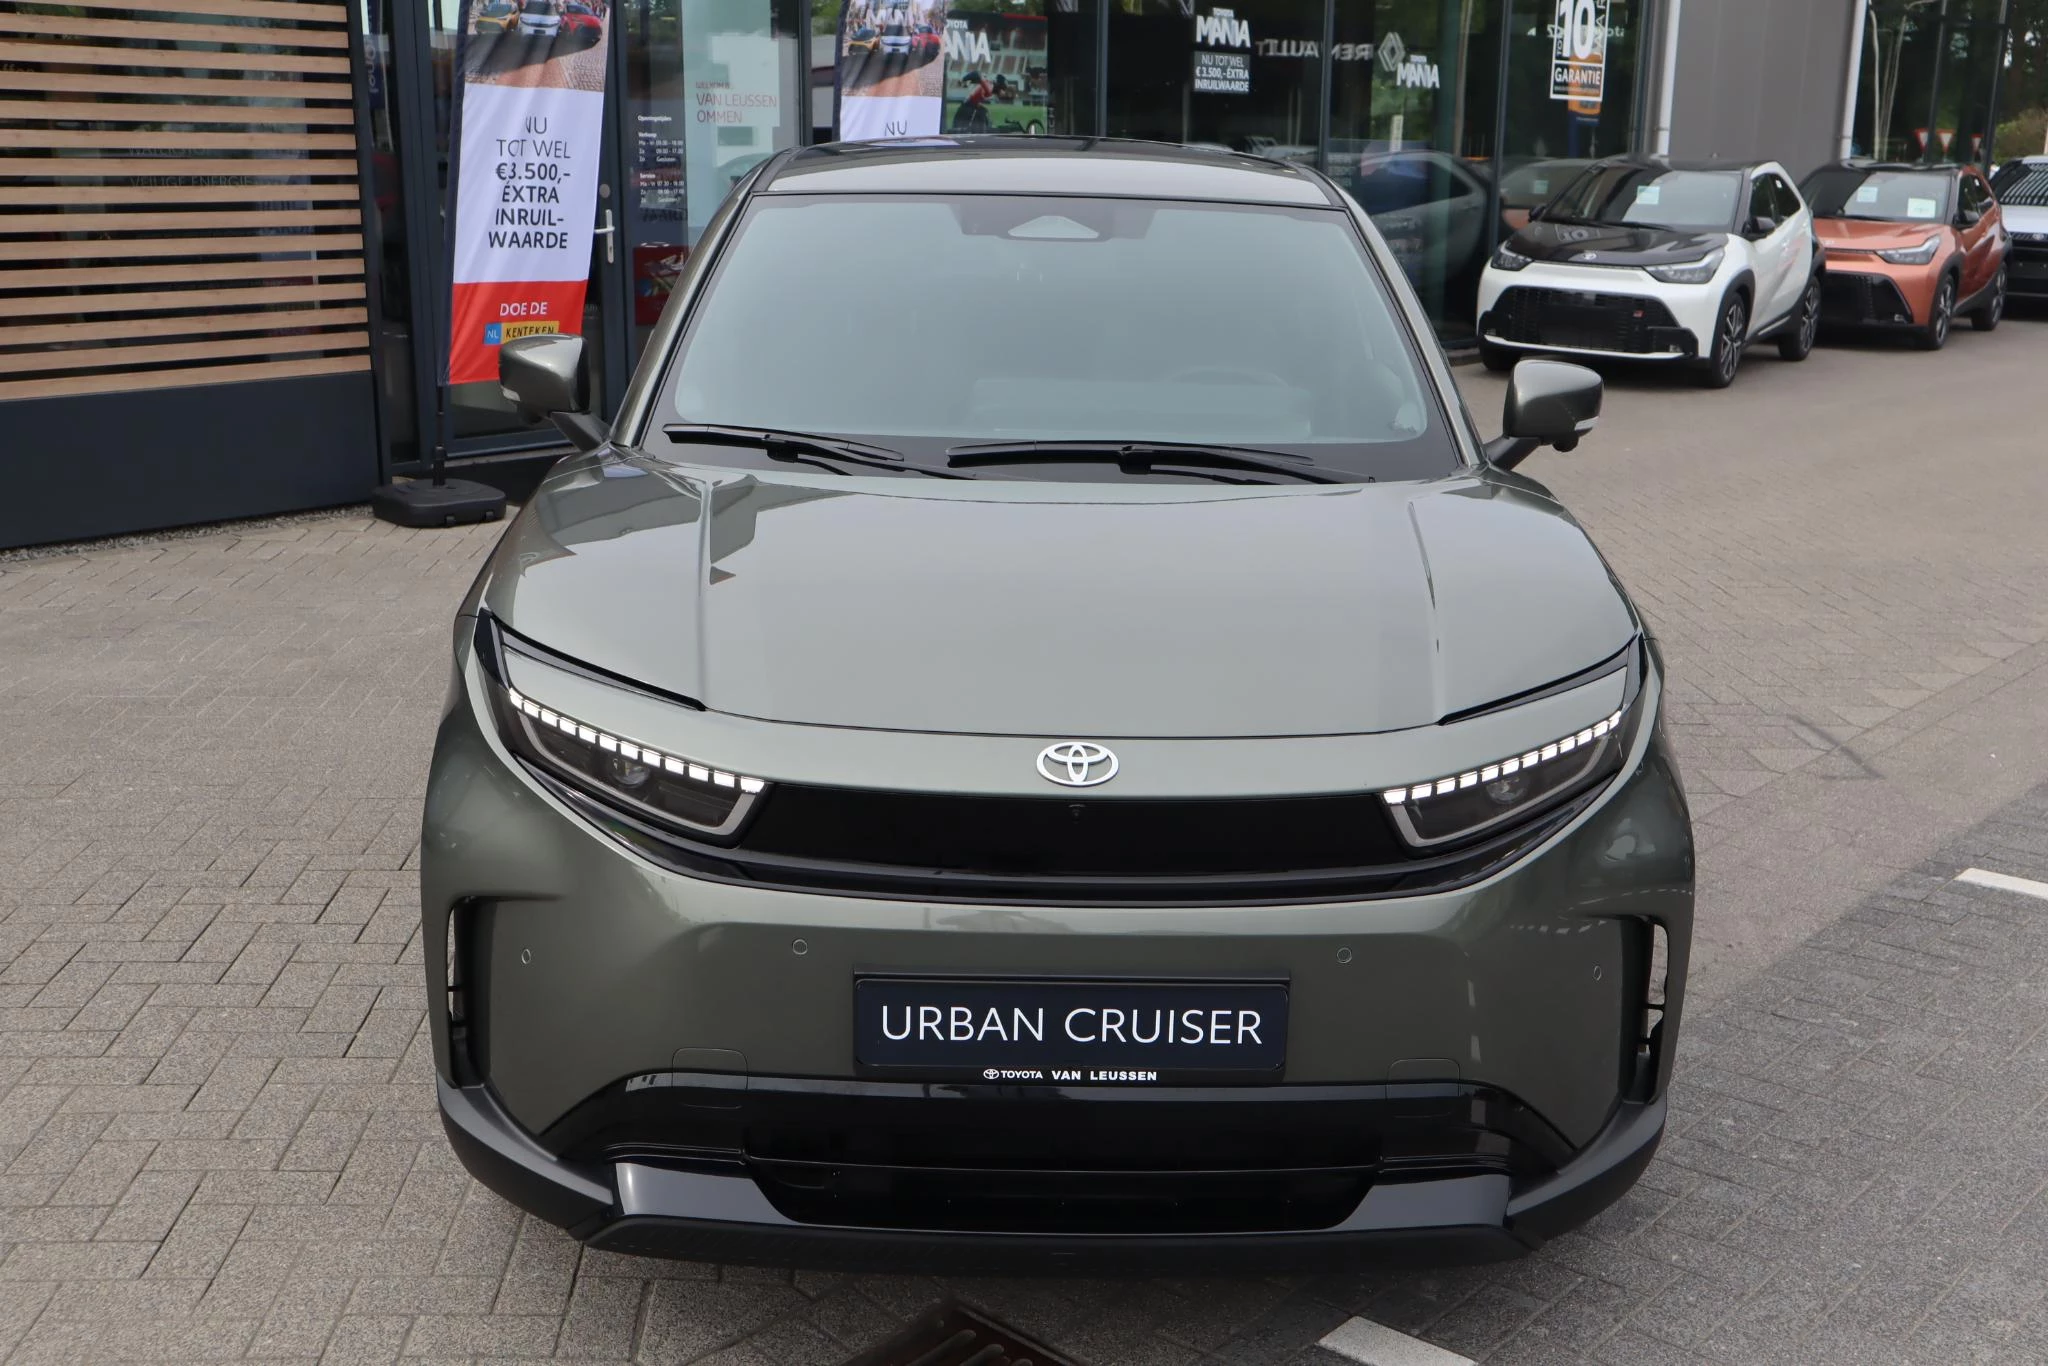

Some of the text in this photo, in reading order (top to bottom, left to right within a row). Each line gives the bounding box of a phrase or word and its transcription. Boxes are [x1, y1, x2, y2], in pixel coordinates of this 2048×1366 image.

[1196, 15, 1251, 48] MANIA
[1559, 0, 1595, 59] 10
[944, 27, 992, 63] ANIA
[1201, 54, 1245, 68] NU TOT WEL
[1396, 62, 1440, 89] MANIA
[1555, 67, 1601, 85] GARANTIE
[696, 93, 721, 106] VAN
[697, 110, 742, 123] OMMEN
[884, 120, 908, 136] NU
[533, 140, 571, 159] WEL
[495, 208, 564, 226] INRUIL-
[488, 231, 568, 249] WAARDE
[500, 302, 548, 316] DOE DE
[487, 328, 500, 339] NL
[505, 326, 555, 339] KENTEKEN
[882, 1005, 1263, 1045] URBAN CRUISER
[1000, 1070, 1158, 1081] TOYOTA VAN LEUSSEN
